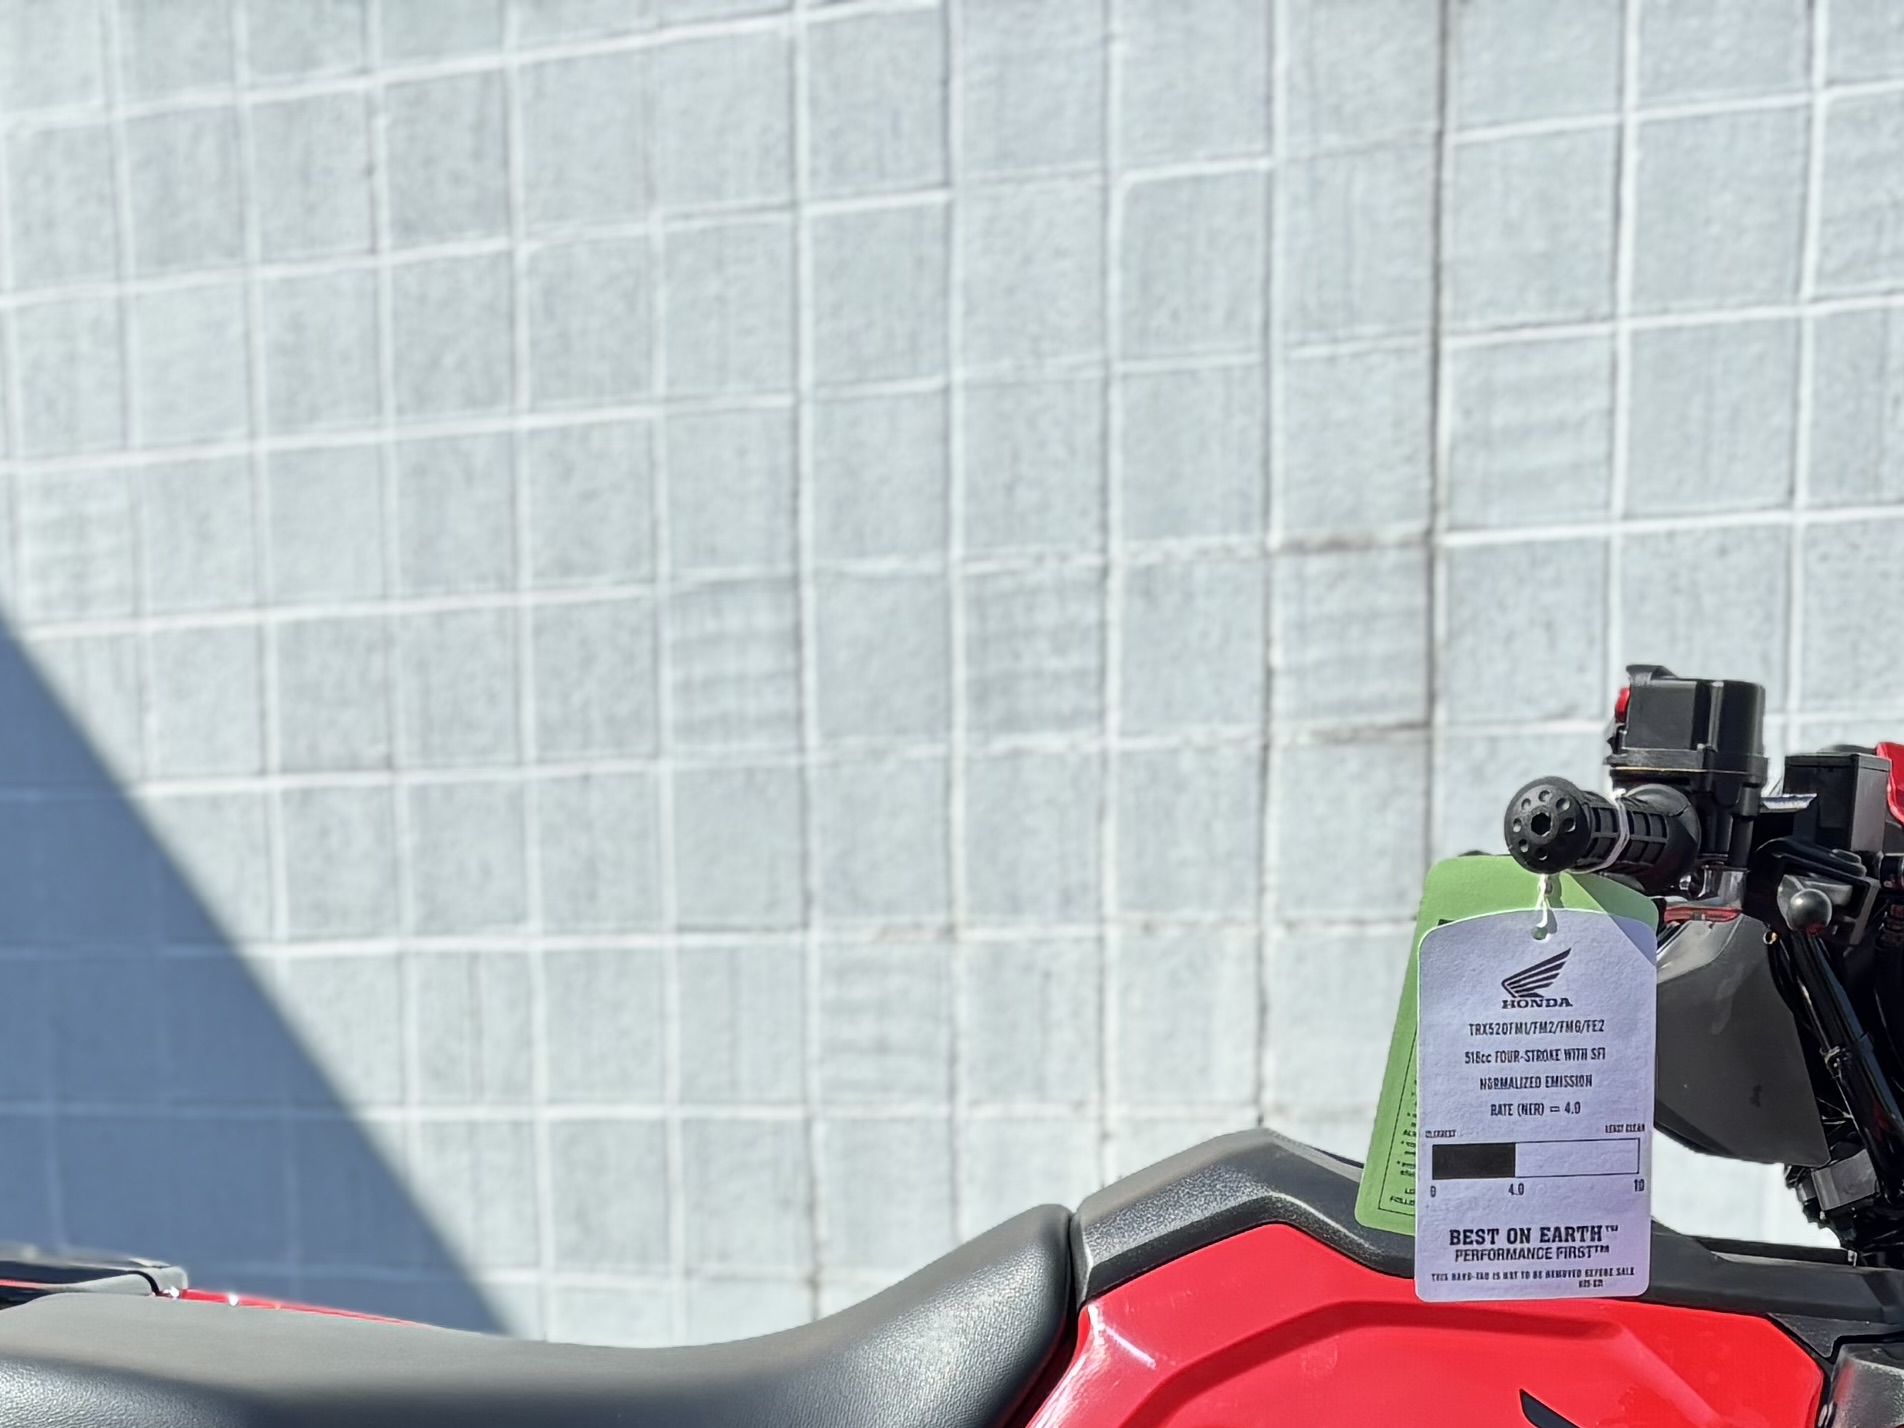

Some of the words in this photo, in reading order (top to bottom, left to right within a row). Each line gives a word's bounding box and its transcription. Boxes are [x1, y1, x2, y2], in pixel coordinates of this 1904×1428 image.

[1501, 998, 1573, 1009] HONDA
[1495, 1048, 1560, 1063] FOUR-STROKE
[1564, 1048, 1587, 1061] WITH
[1480, 1076, 1542, 1091] NORMALIZED
[1545, 1074, 1593, 1088] EMISSION
[1490, 1103, 1514, 1117] RATE
[1516, 1102, 1545, 1117] (NER)
[1564, 1101, 1581, 1115] 4.0
[1429, 1185, 1437, 1198] 0
[1508, 1182, 1525, 1196] 4.0
[1633, 1179, 1645, 1192] 10
[1449, 1228, 1500, 1246] BEST
[1506, 1226, 1531, 1245] ON
[1454, 1246, 1553, 1263] PERFORMANCE
